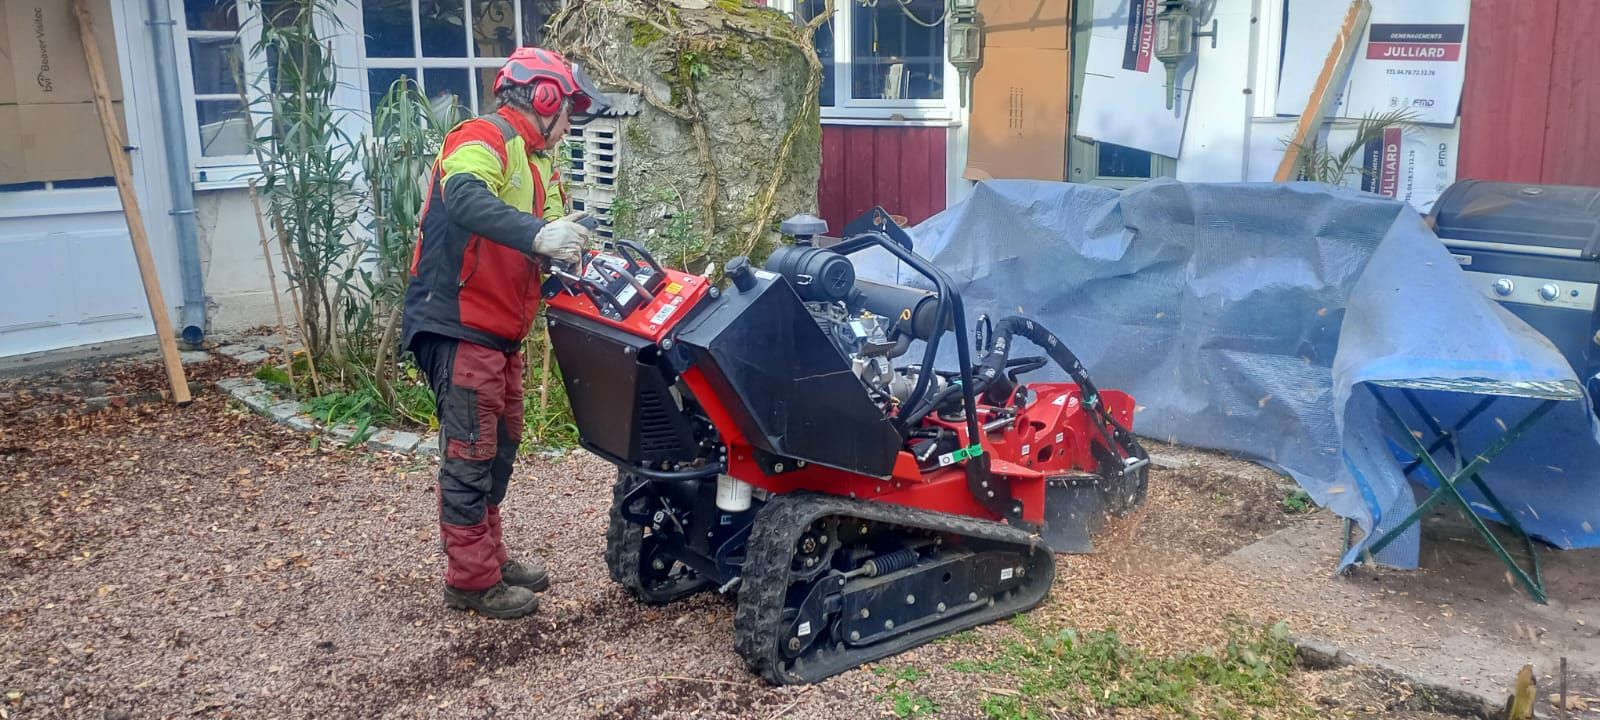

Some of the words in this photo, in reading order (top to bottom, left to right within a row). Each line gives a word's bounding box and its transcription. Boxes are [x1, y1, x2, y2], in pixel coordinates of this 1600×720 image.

[34, 8, 44, 38] Visitec
[1141, 0, 1155, 56] JULLIARD
[39, 39, 49, 71] Beaver
[1384, 46, 1445, 58] JULLIARD
[1383, 144, 1397, 198] ULLIARD
